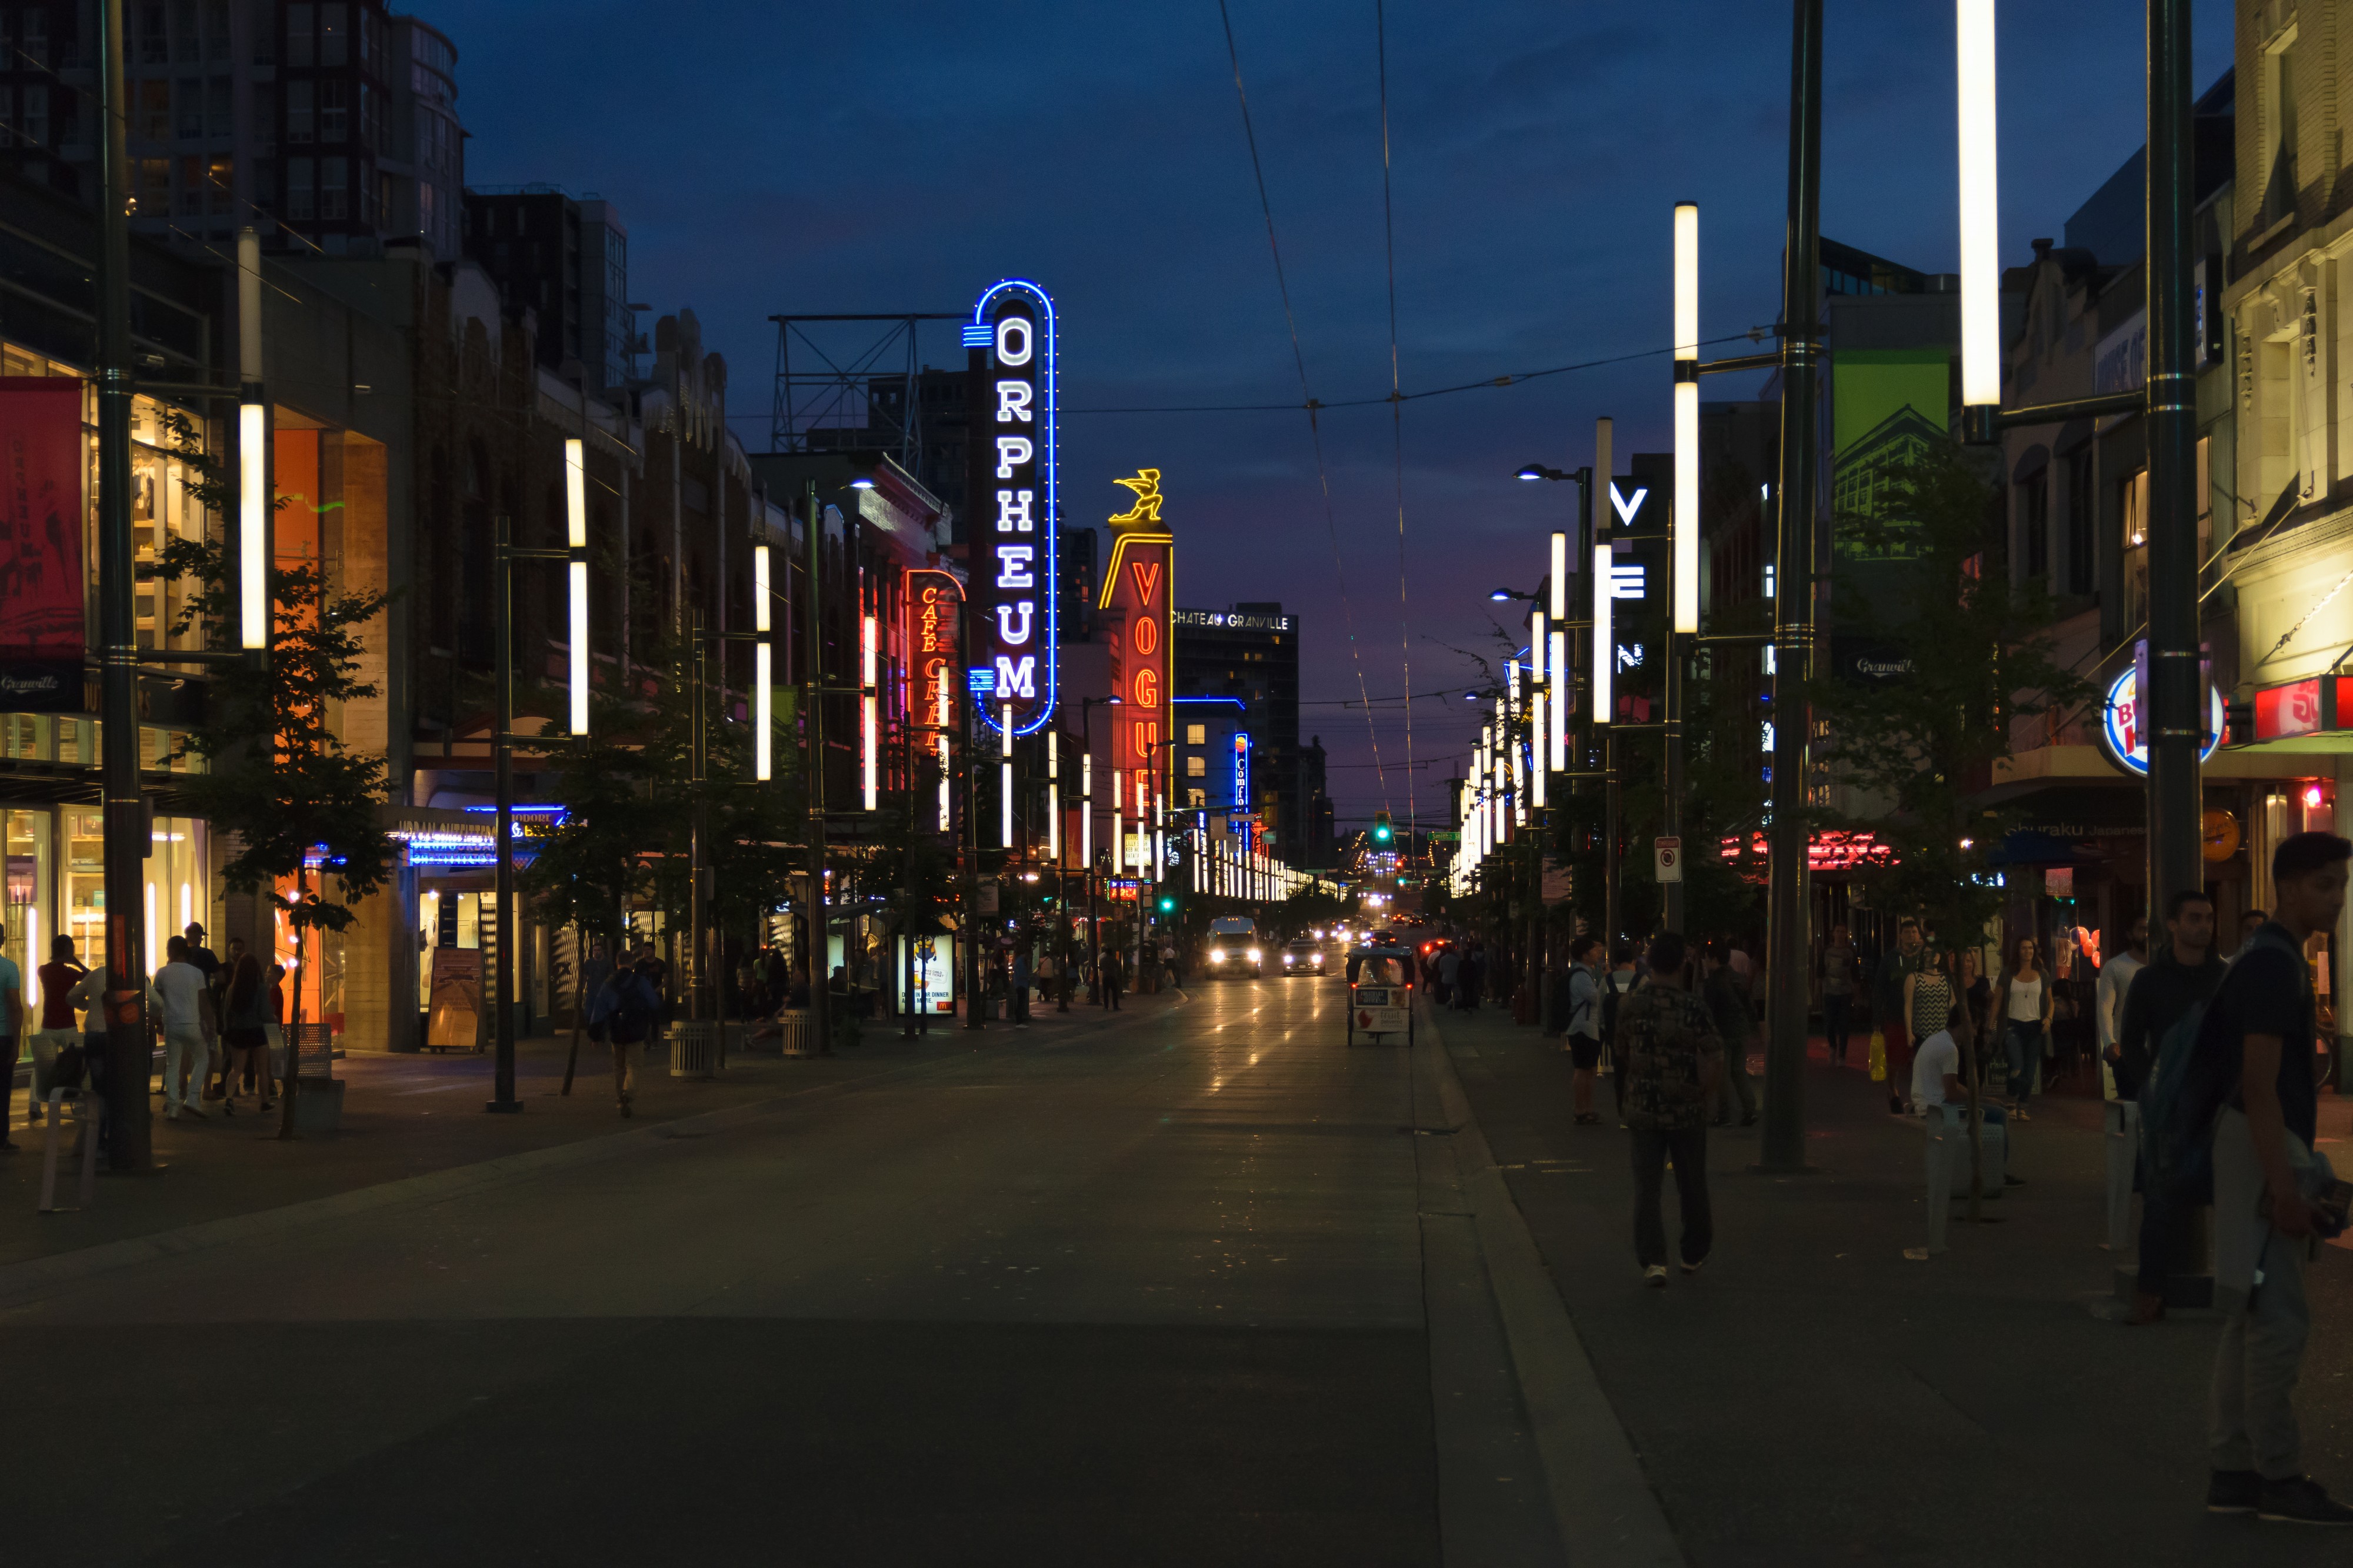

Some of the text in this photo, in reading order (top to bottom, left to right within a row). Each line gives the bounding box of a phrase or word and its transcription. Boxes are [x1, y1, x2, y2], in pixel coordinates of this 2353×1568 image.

[995, 316, 1035, 699] ORPHEUM
[921, 588, 938, 652] CAFÉ
[1170, 610, 1288, 630] CHATEAU GRANVILLE
[1, 675, 58, 689] Granville
[1132, 562, 1159, 806] VOGUE
[1237, 759, 1246, 811] Comfo
